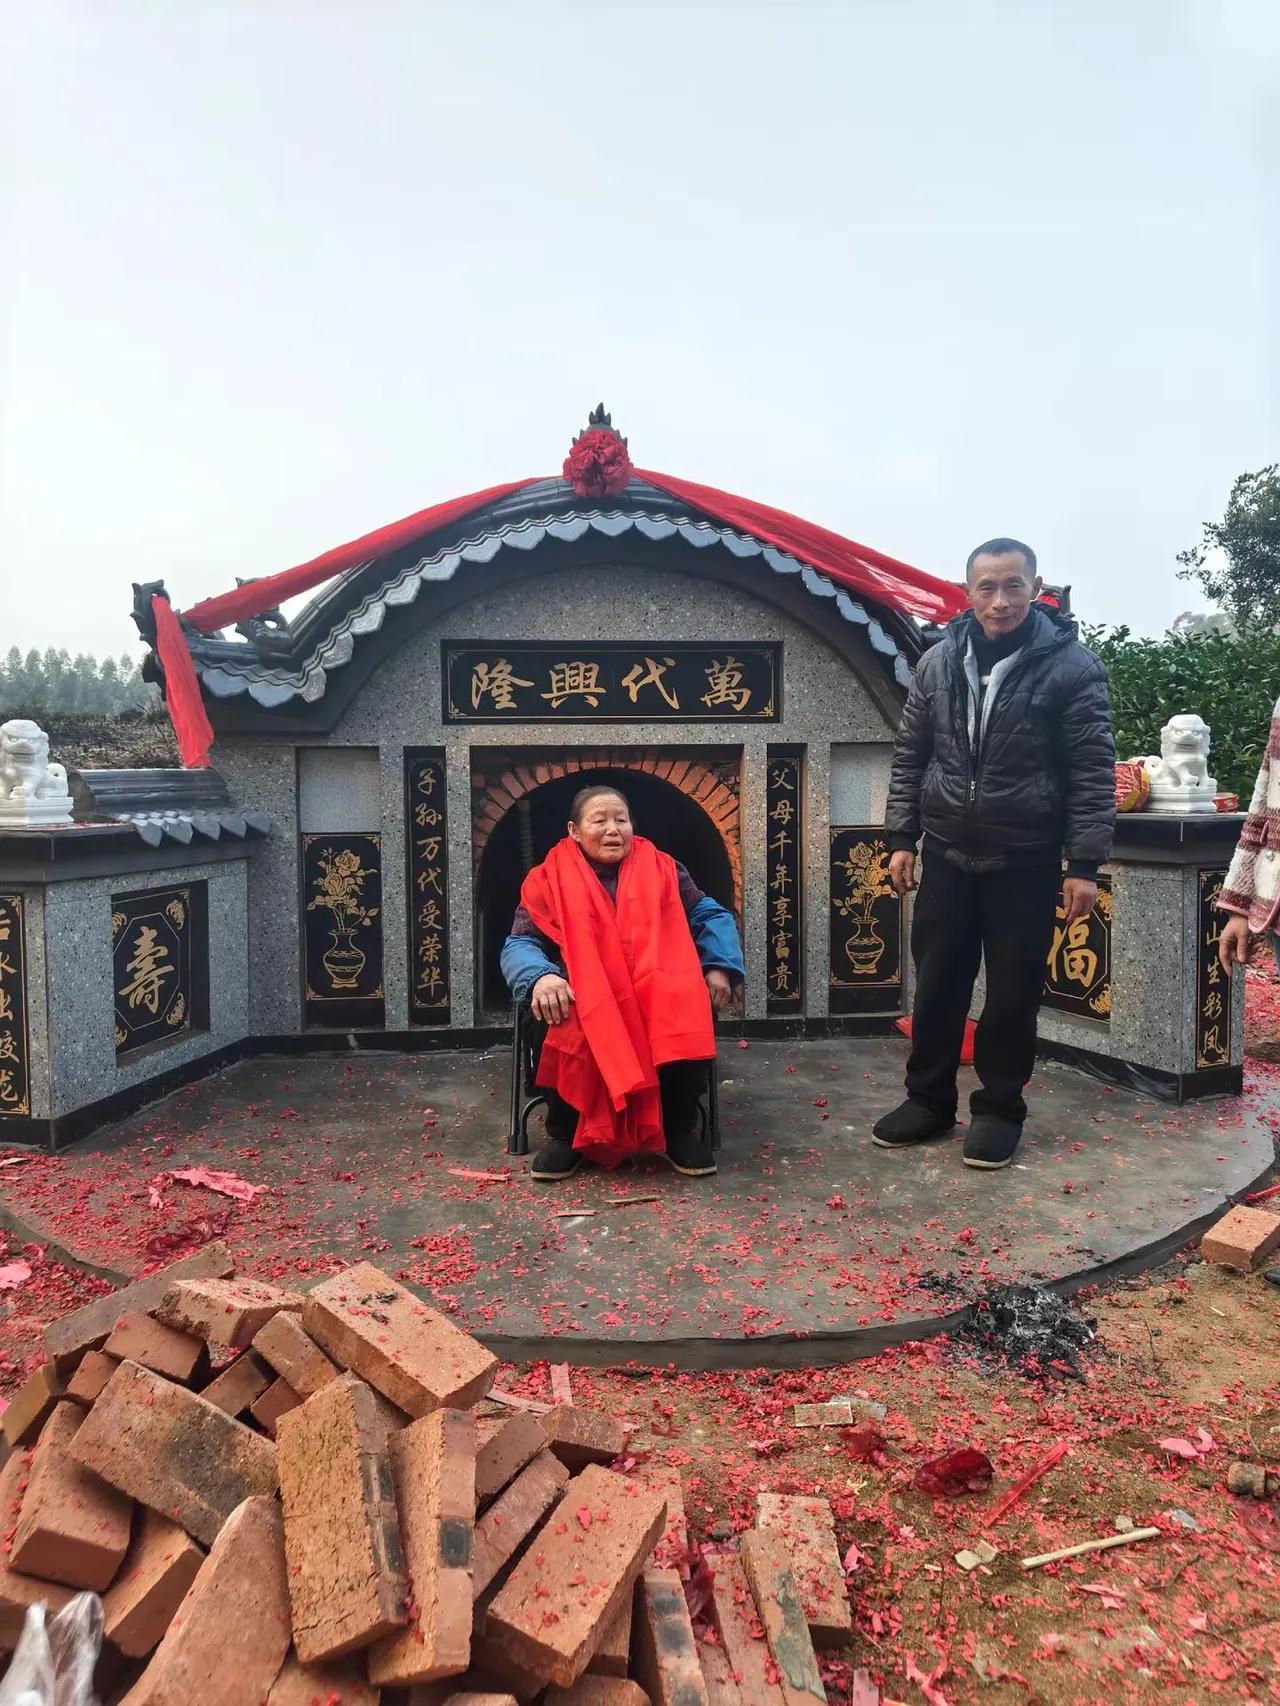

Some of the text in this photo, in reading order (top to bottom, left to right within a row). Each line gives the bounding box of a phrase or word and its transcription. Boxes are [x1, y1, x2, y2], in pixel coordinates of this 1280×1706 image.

[415, 768, 444, 998] 子孙万代受荣华
[768, 767, 796, 991] 父母千年享富贵
[1047, 905, 1098, 987] 福
[119, 925, 176, 1015] 壽
